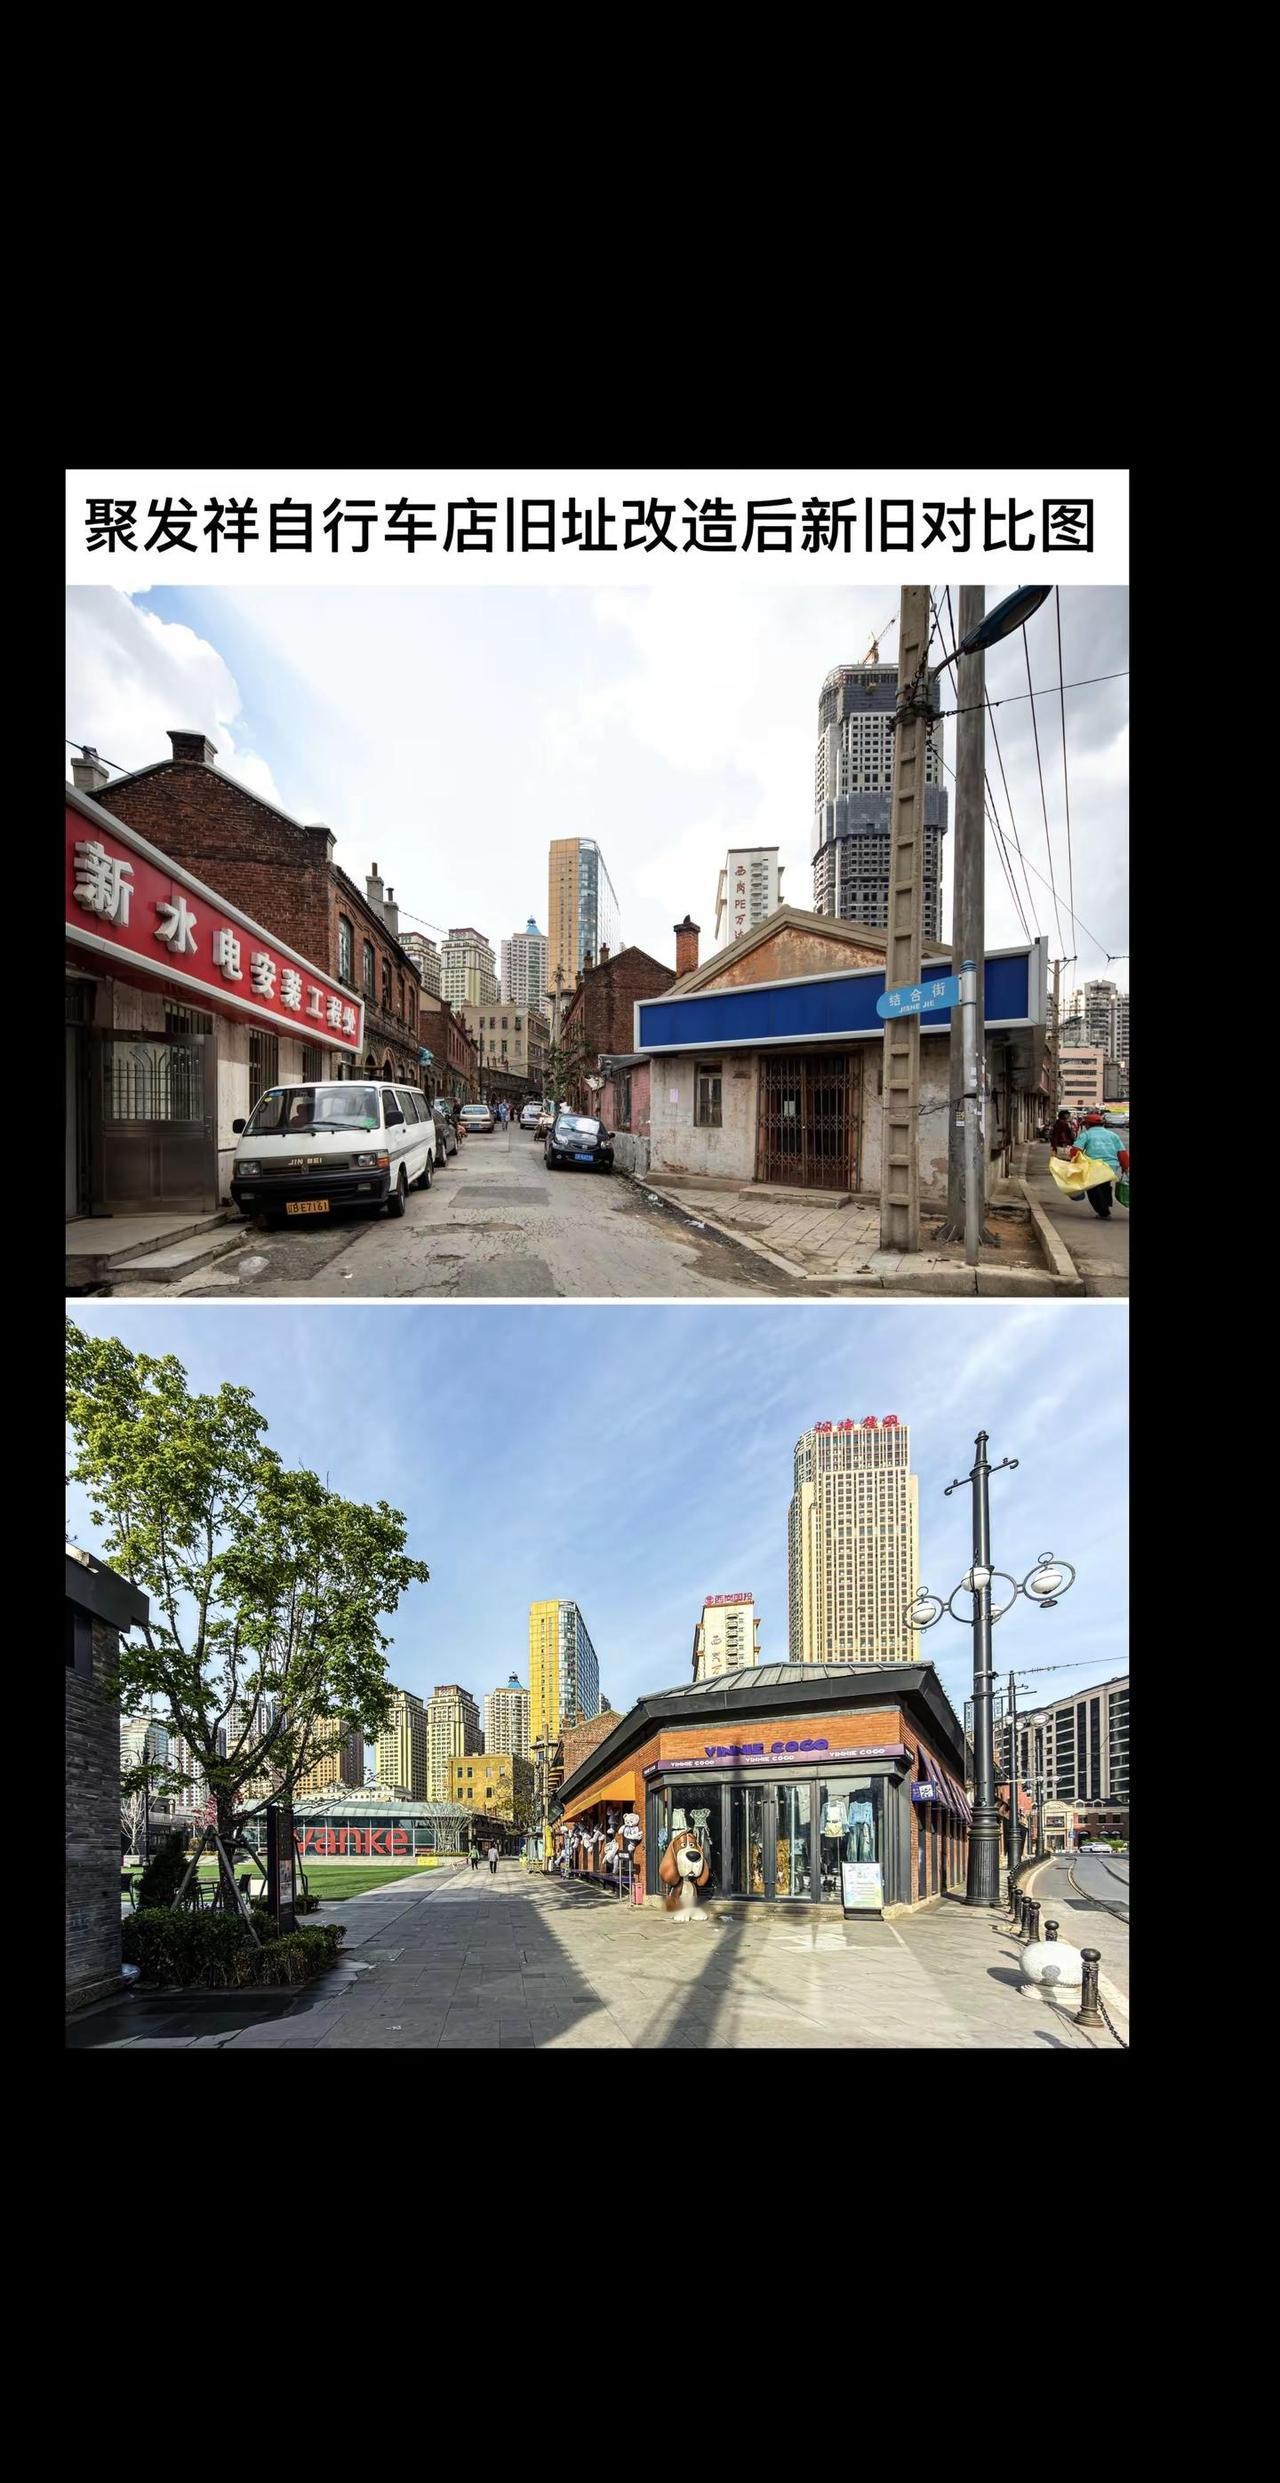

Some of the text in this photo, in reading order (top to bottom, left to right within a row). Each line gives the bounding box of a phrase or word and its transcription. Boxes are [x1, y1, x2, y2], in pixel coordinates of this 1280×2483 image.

[888, 982, 945, 1007] 结合街
[704, 1743, 763, 1758] VINNIE
[293, 1827, 408, 1855] vanke
